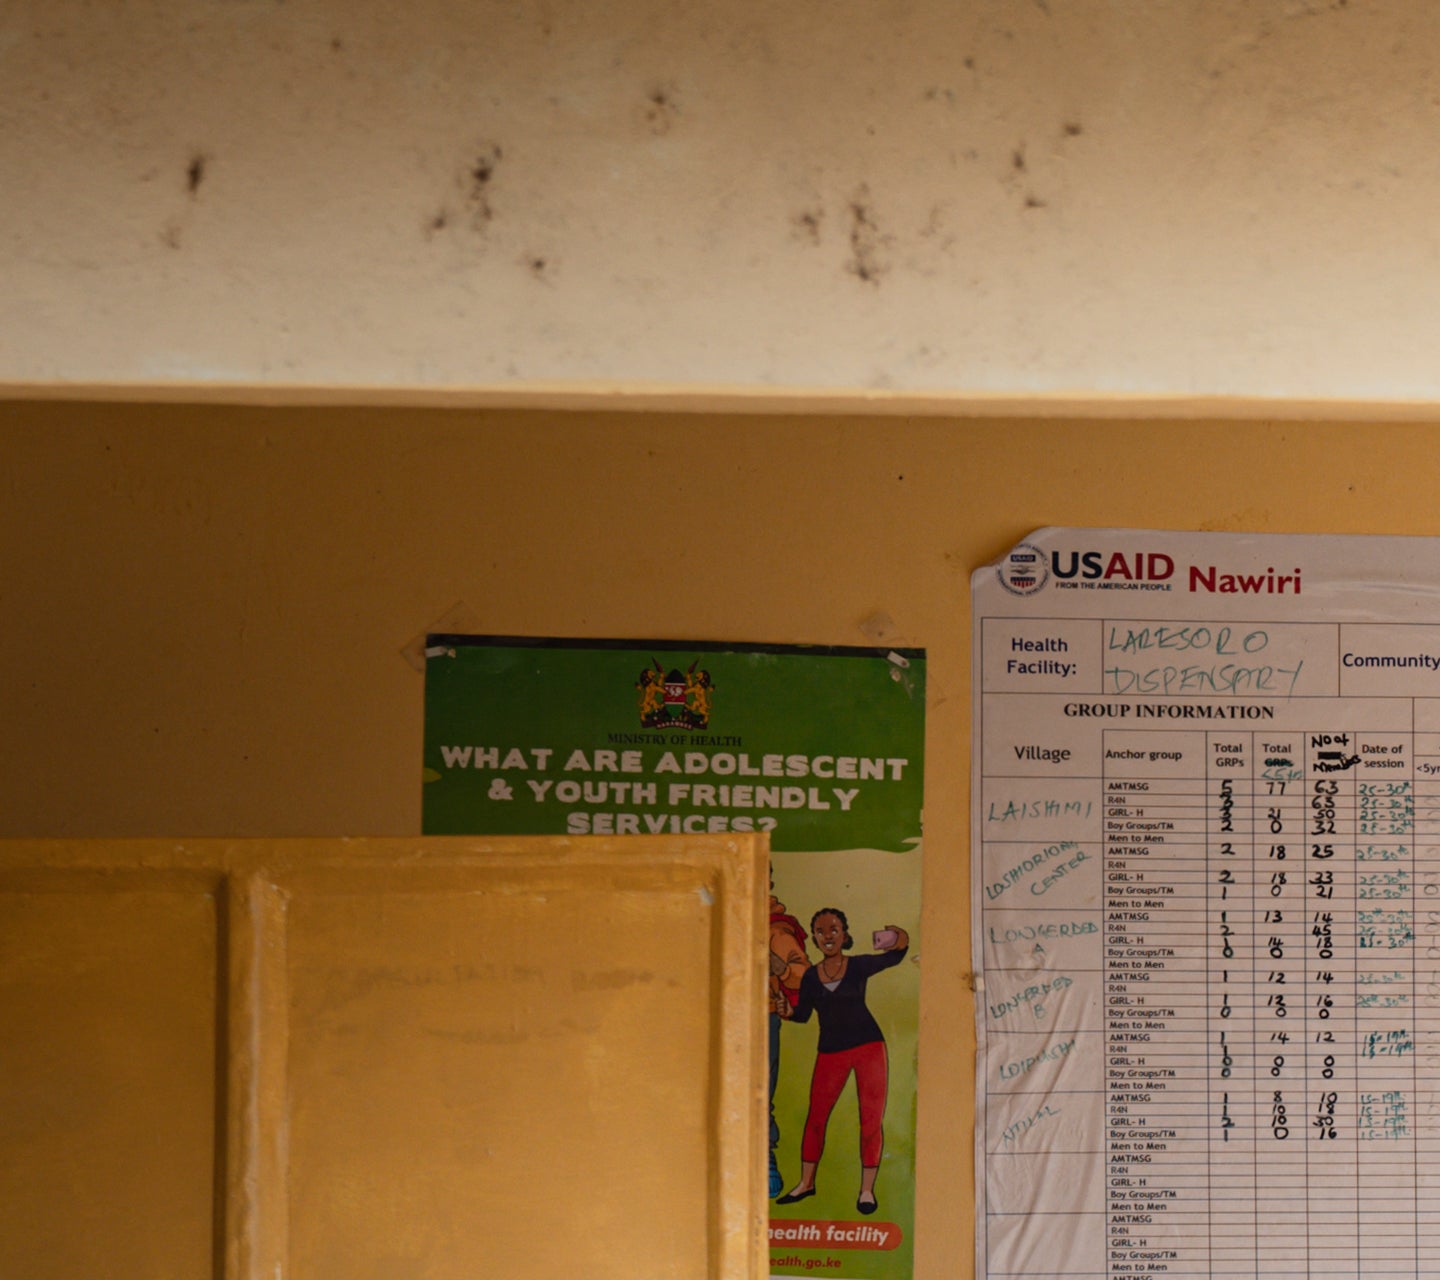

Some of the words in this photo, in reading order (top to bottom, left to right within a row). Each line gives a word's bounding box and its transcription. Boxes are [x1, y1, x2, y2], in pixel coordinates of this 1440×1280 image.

[1052, 551, 1175, 581] USAID
[1189, 566, 1302, 594] Nawiri
[1056, 582, 1078, 590] FROM
[1080, 582, 1096, 590] THE
[1097, 583, 1138, 591] AMERICAN
[1140, 583, 1172, 591] PEOPLE
[1011, 637, 1068, 652] Health
[1007, 660, 1077, 677] Facility:
[1343, 653, 1440, 670] Community
[1064, 703, 1130, 718] GROUP
[1136, 704, 1274, 719] INFORMATION
[608, 733, 667, 746] MINISTRY
[670, 735, 687, 746] OF
[690, 736, 742, 747] HEALTH
[1014, 745, 1071, 762] Village
[1214, 743, 1243, 754] Total
[1262, 743, 1291, 754] Total
[1362, 744, 1388, 754] Date
[1391, 745, 1403, 754] of
[1105, 749, 1145, 761] Anchor
[1149, 751, 1182, 763] group
[1216, 757, 1244, 768] GRPs
[440, 746, 553, 771] WHAT
[564, 750, 643, 773] ARE
[654, 752, 908, 781] ADOLESCENT
[1364, 759, 1405, 768] session
[1108, 782, 1149, 791] AMTMSG
[488, 778, 513, 801] &
[527, 780, 656, 804] YOUTH
[668, 784, 860, 810] FRIENDLY
[567, 812, 778, 834] SERVICES?
[1108, 821, 1125, 832] Boy
[1108, 834, 1126, 842] Men
[1129, 834, 1139, 843] to
[1143, 834, 1164, 842] Men
[827, 1225, 889, 1246] facility
[769, 1256, 842, 1269] ealth.go.ke
